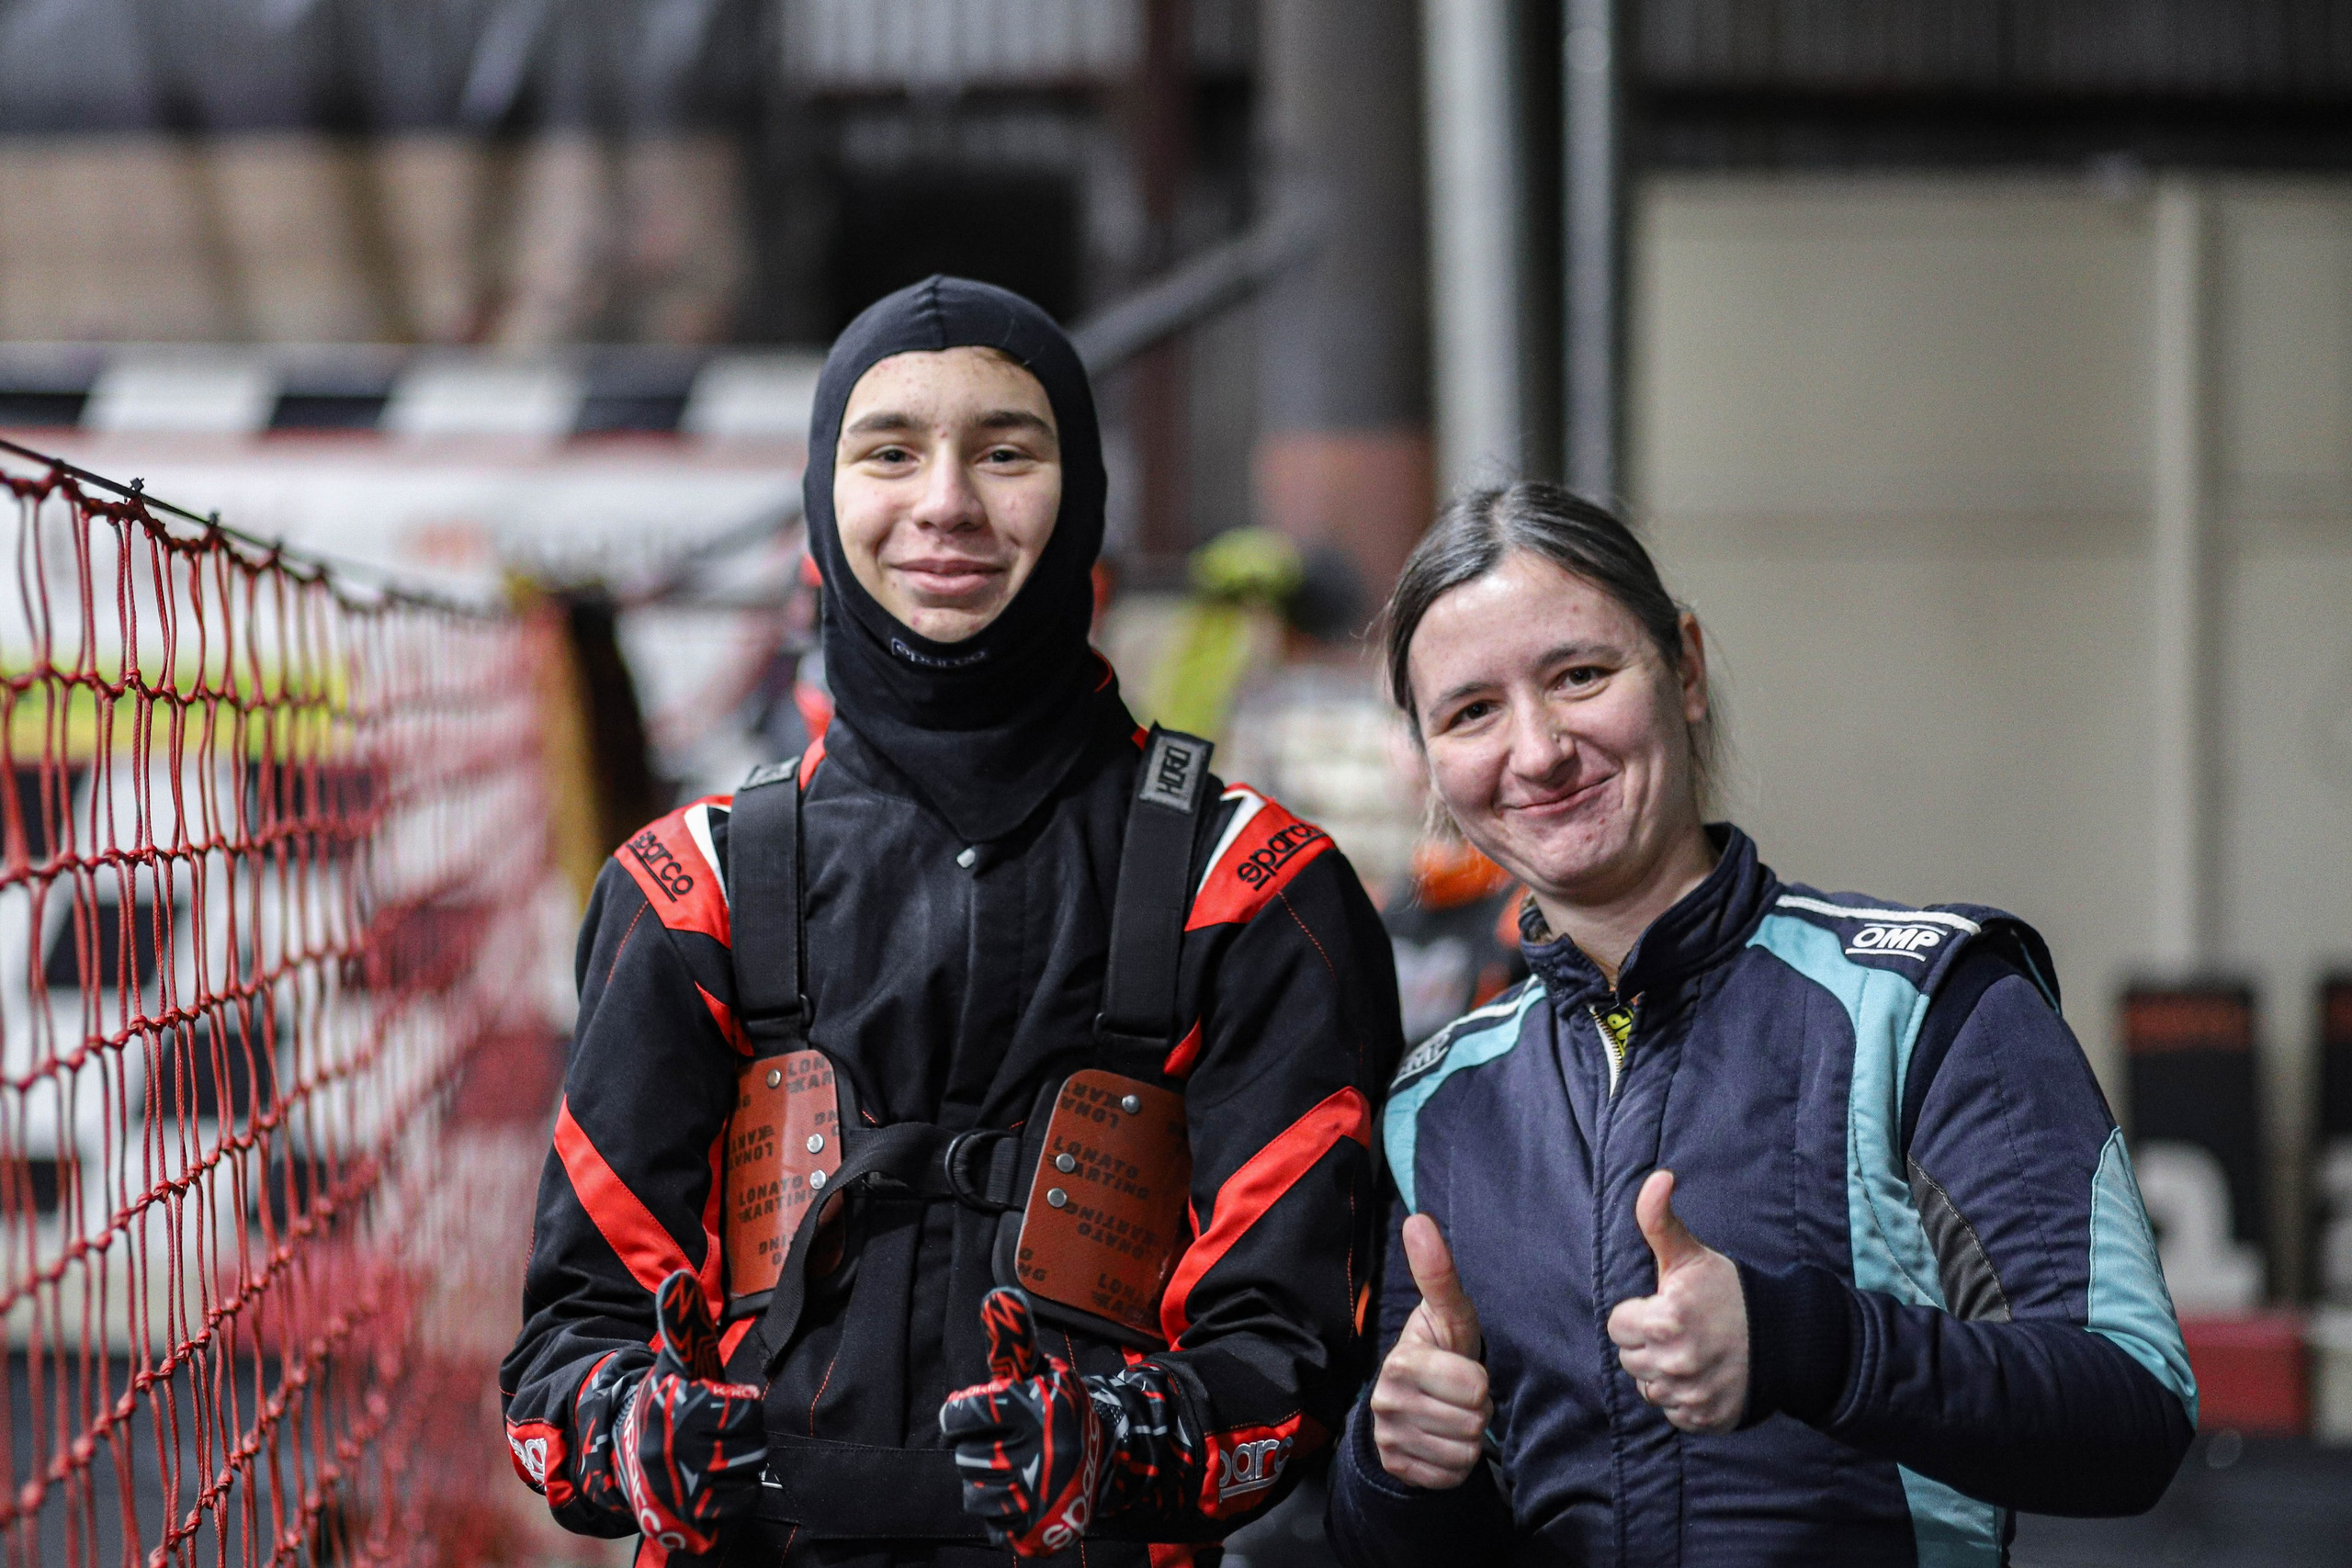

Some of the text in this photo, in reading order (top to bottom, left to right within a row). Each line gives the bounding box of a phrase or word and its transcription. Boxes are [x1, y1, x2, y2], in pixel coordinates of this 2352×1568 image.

[1851, 926, 1940, 952] OMP
[738, 1176, 803, 1207] LONATO
[1048, 1154, 1148, 1201] ARTING
